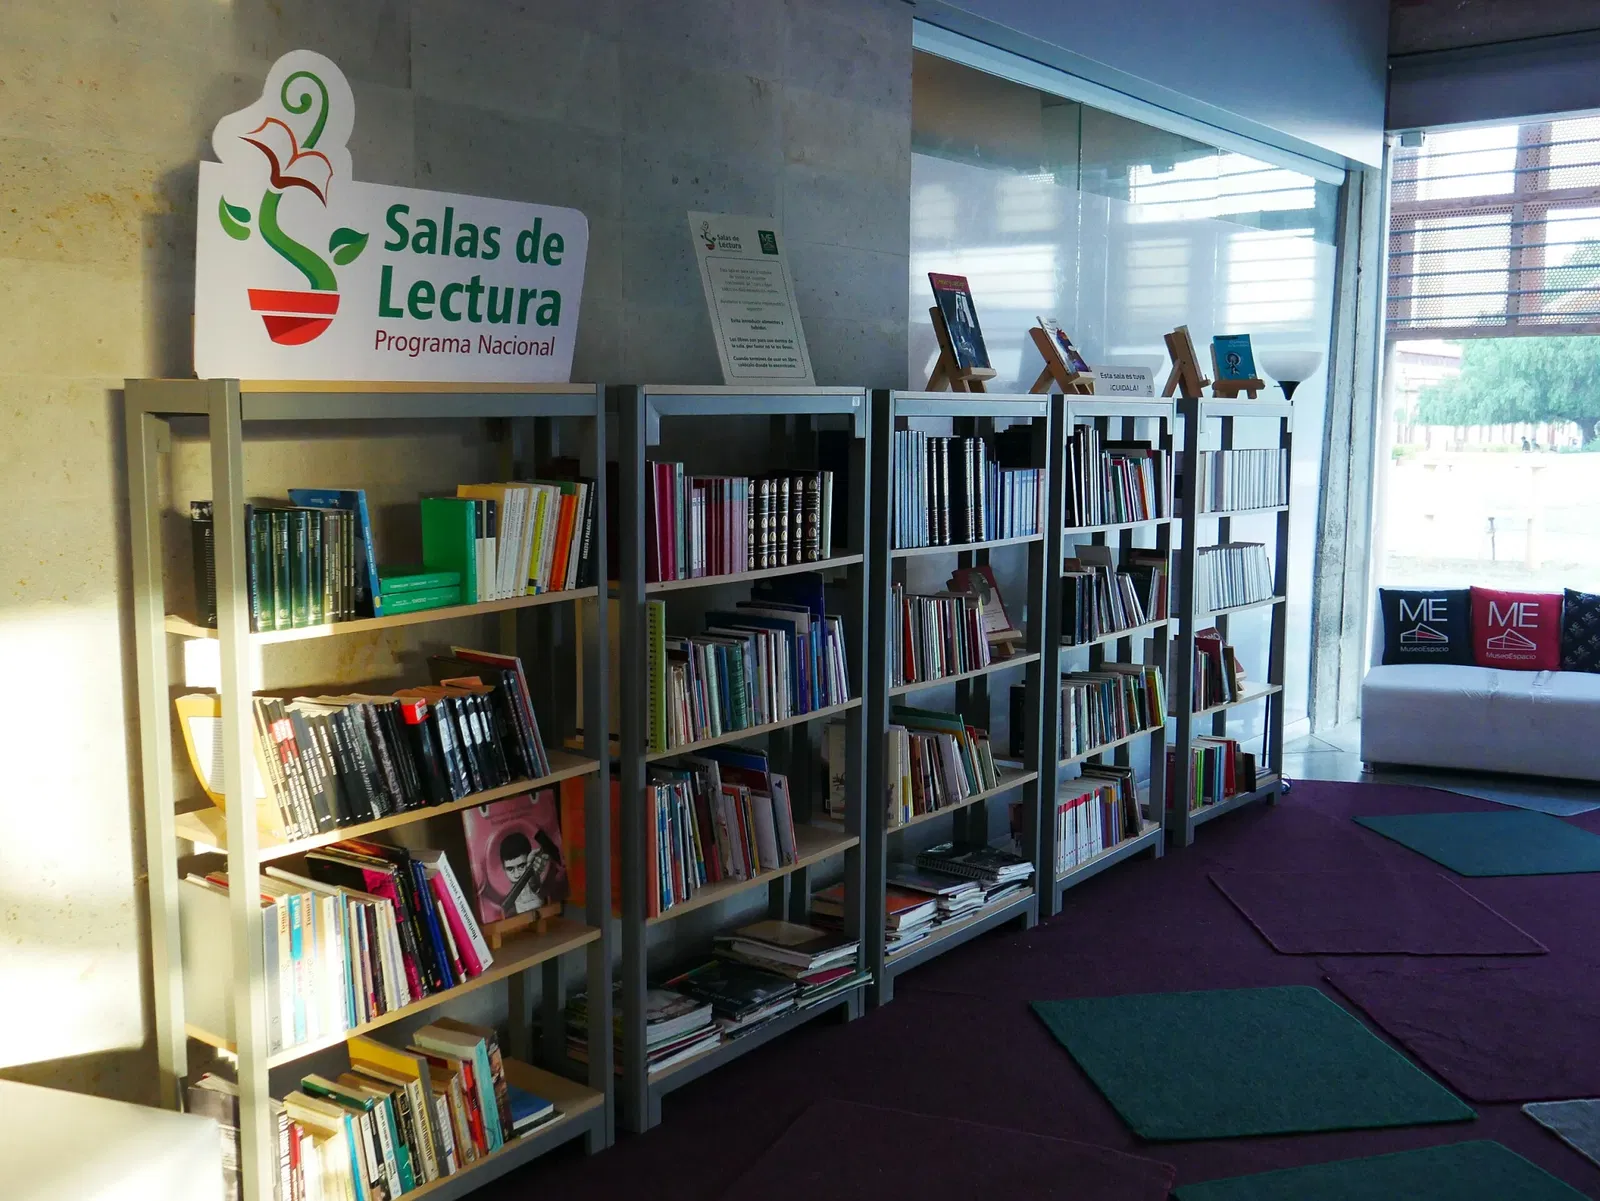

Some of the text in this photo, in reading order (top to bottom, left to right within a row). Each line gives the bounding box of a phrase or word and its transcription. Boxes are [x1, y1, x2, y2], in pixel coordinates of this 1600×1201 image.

[384, 203, 565, 266] Salas de
[717, 234, 733, 242] Salas
[718, 241, 742, 250] Lectura
[378, 265, 563, 327] Lectura
[374, 329, 556, 357] Programa Nacional
[1100, 372, 1113, 380] Esta
[1113, 372, 1126, 380] sala
[1133, 373, 1146, 381] tuya
[1400, 598, 1448, 622] ME
[1488, 601, 1539, 628] ME
[1400, 645, 1449, 653] MuseoEspacio
[1486, 652, 1536, 660] MuseoEspacio
[443, 865, 459, 894] verticales
[459, 901, 478, 941] Horizontales
